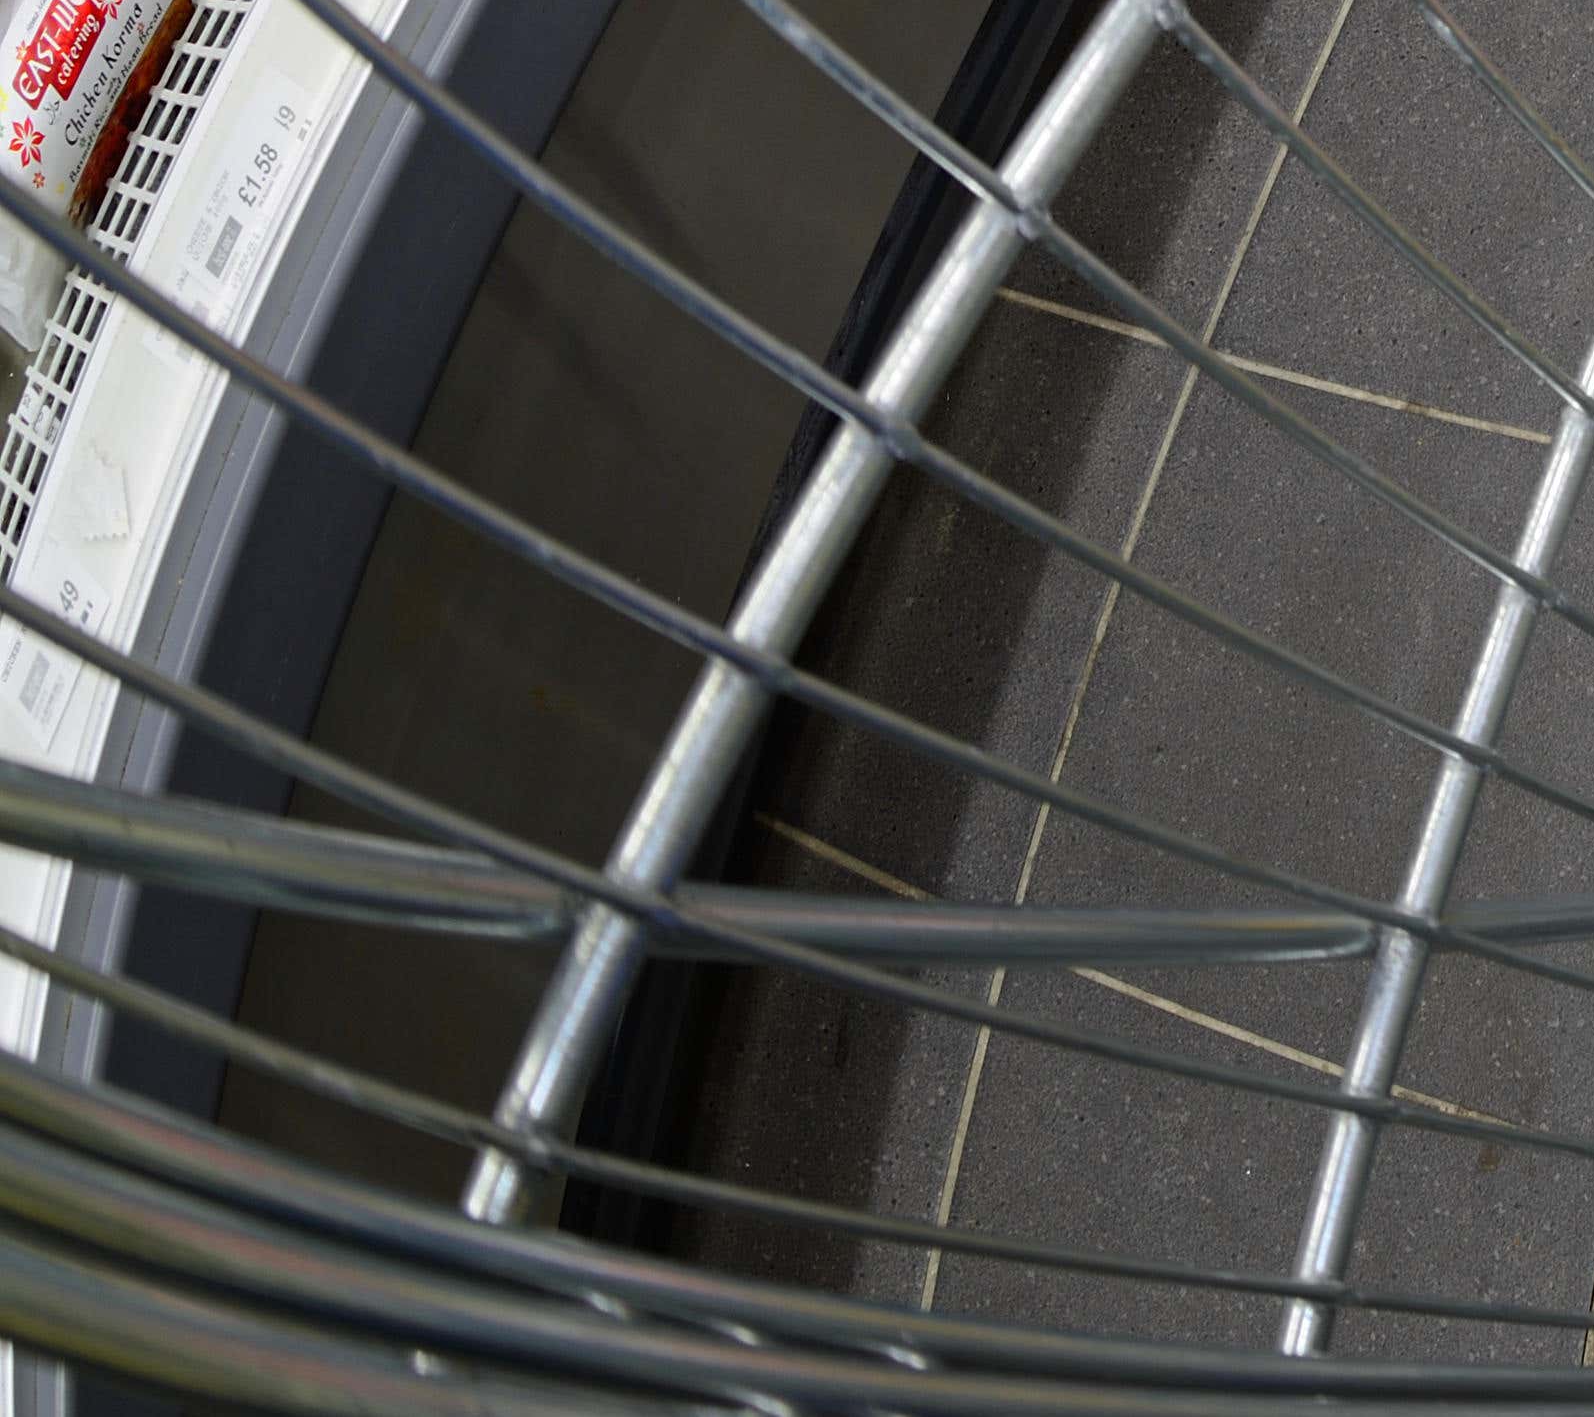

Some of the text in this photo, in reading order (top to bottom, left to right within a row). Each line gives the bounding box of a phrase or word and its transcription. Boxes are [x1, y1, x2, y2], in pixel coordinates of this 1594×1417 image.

[56, 13, 100, 86] catering
[64, 2, 144, 148] Chicken Korma
[238, 142, 279, 207] £1.58
